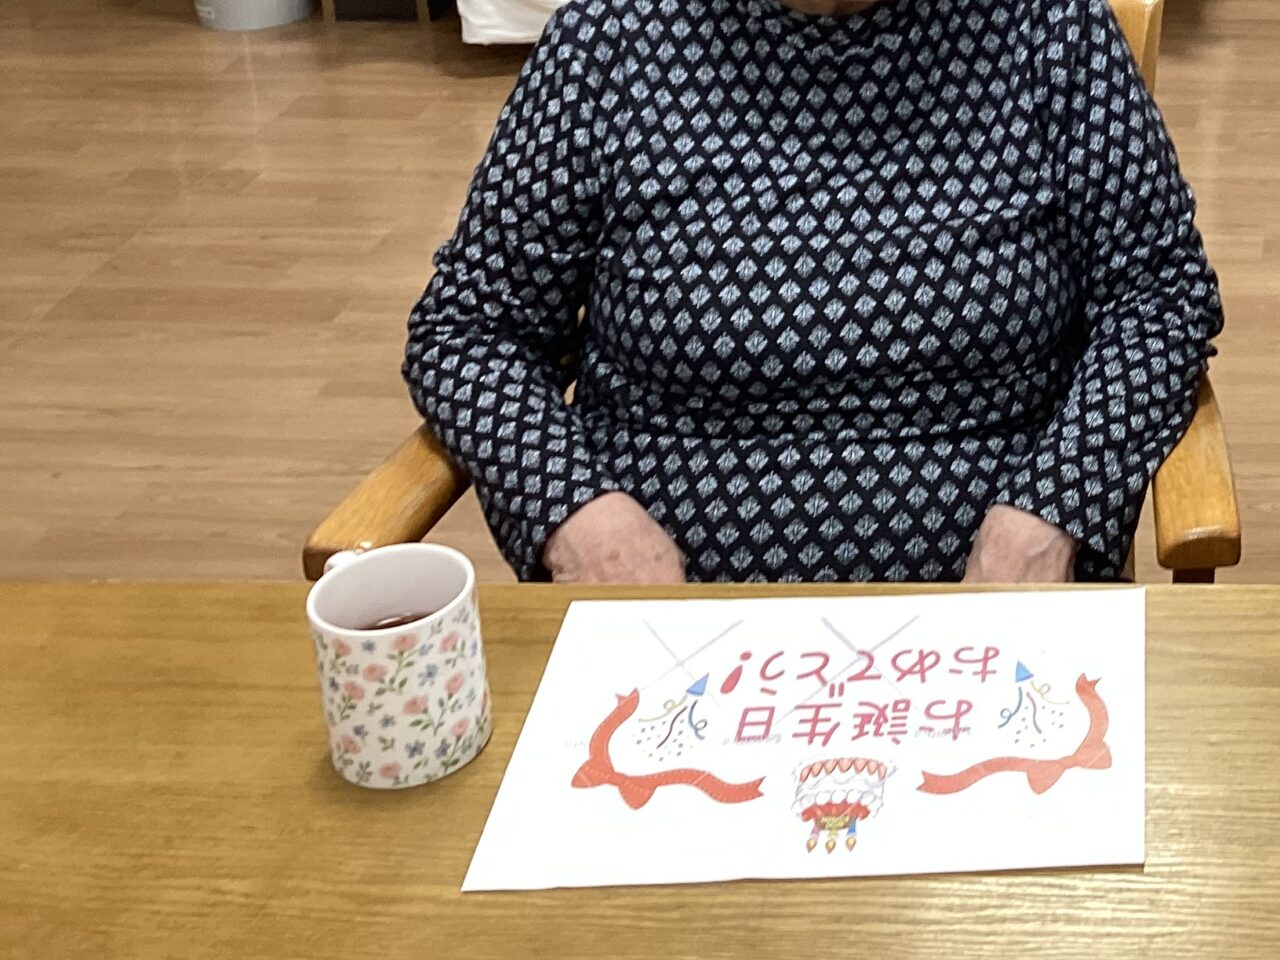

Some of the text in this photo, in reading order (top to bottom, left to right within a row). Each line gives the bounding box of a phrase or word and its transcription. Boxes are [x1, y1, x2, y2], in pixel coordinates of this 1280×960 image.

[719, 646, 1000, 698] おめでとう!
[734, 698, 974, 747] お誕生日
